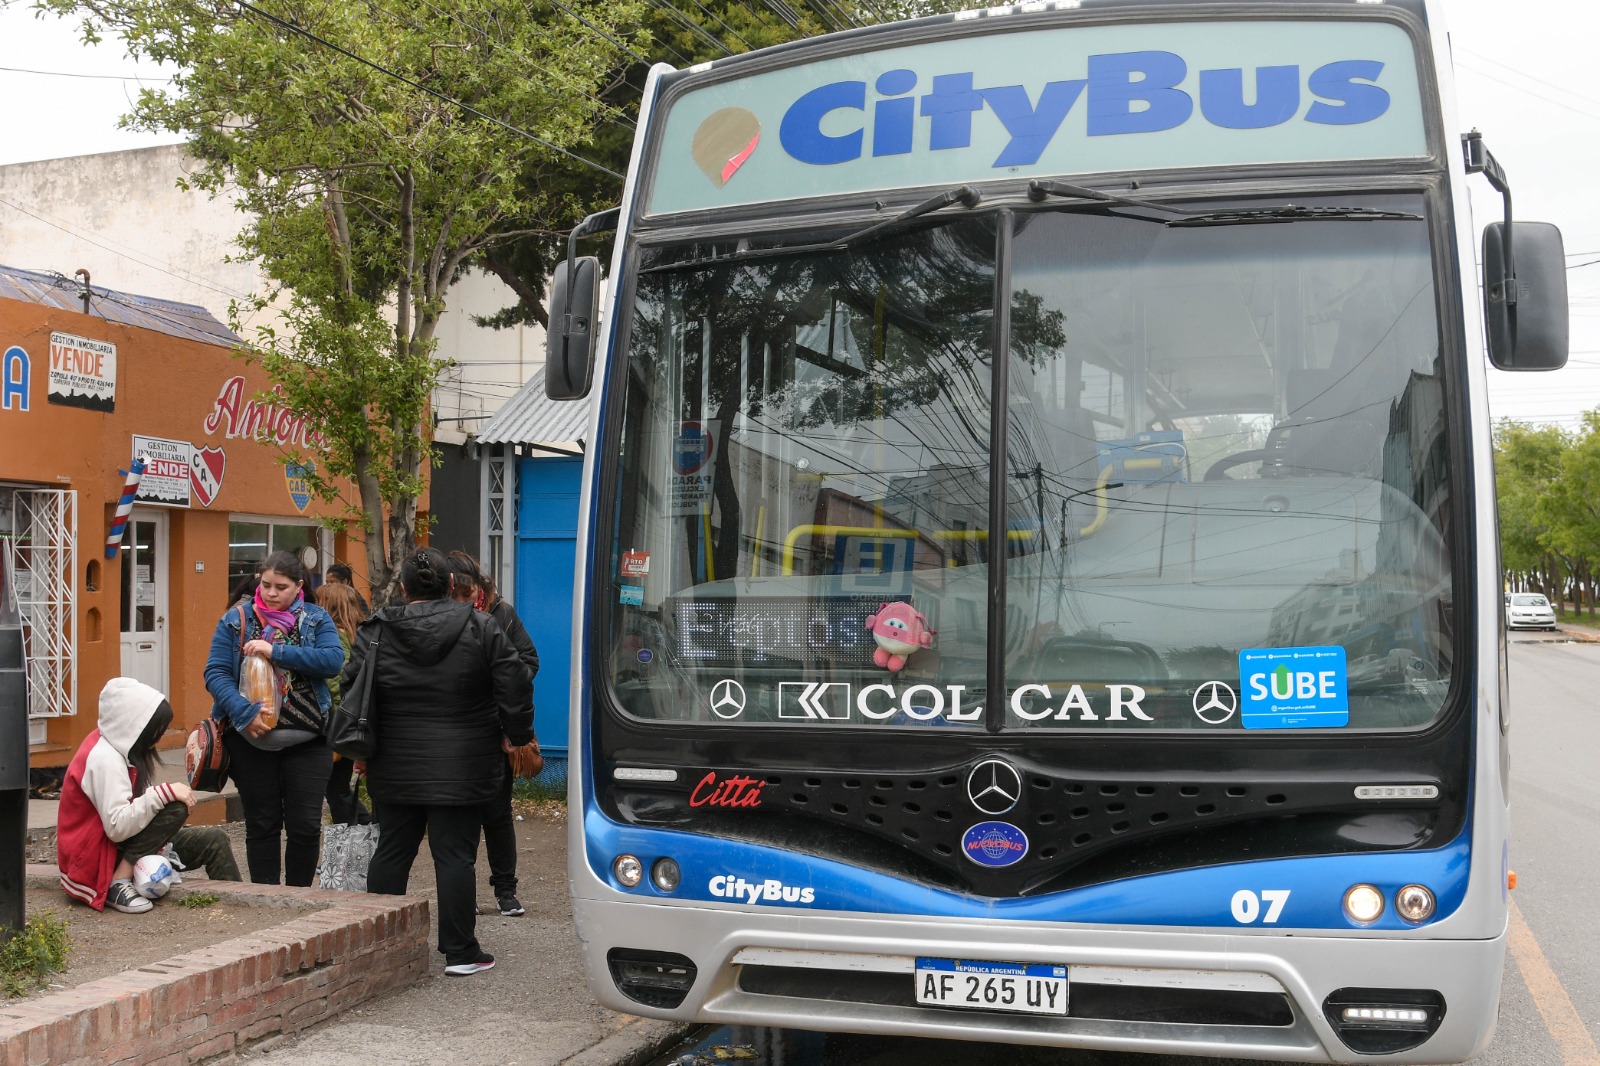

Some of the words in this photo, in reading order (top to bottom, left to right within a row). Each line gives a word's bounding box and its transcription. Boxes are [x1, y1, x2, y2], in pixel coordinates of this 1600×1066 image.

[779, 50, 1391, 168] CityBus
[51, 335, 75, 346] GESTION
[77, 340, 113, 354] INMOBILIARIA
[52, 344, 105, 378] VENDE
[147, 441, 178, 452] GESTION
[147, 461, 188, 478] ENDE
[857, 684, 983, 720] COL
[1011, 684, 1154, 720] CAR
[1249, 671, 1337, 701] SUBE
[689, 771, 766, 808] Cittá
[708, 875, 815, 904] CityBus
[1231, 889, 1291, 924] 07
[955, 965, 989, 974] REPÚBLICA
[990, 967, 1027, 976] ARGENTINA
[923, 973, 954, 1000] AF
[966, 976, 1016, 1004] 265
[1026, 980, 1059, 1008] UY
